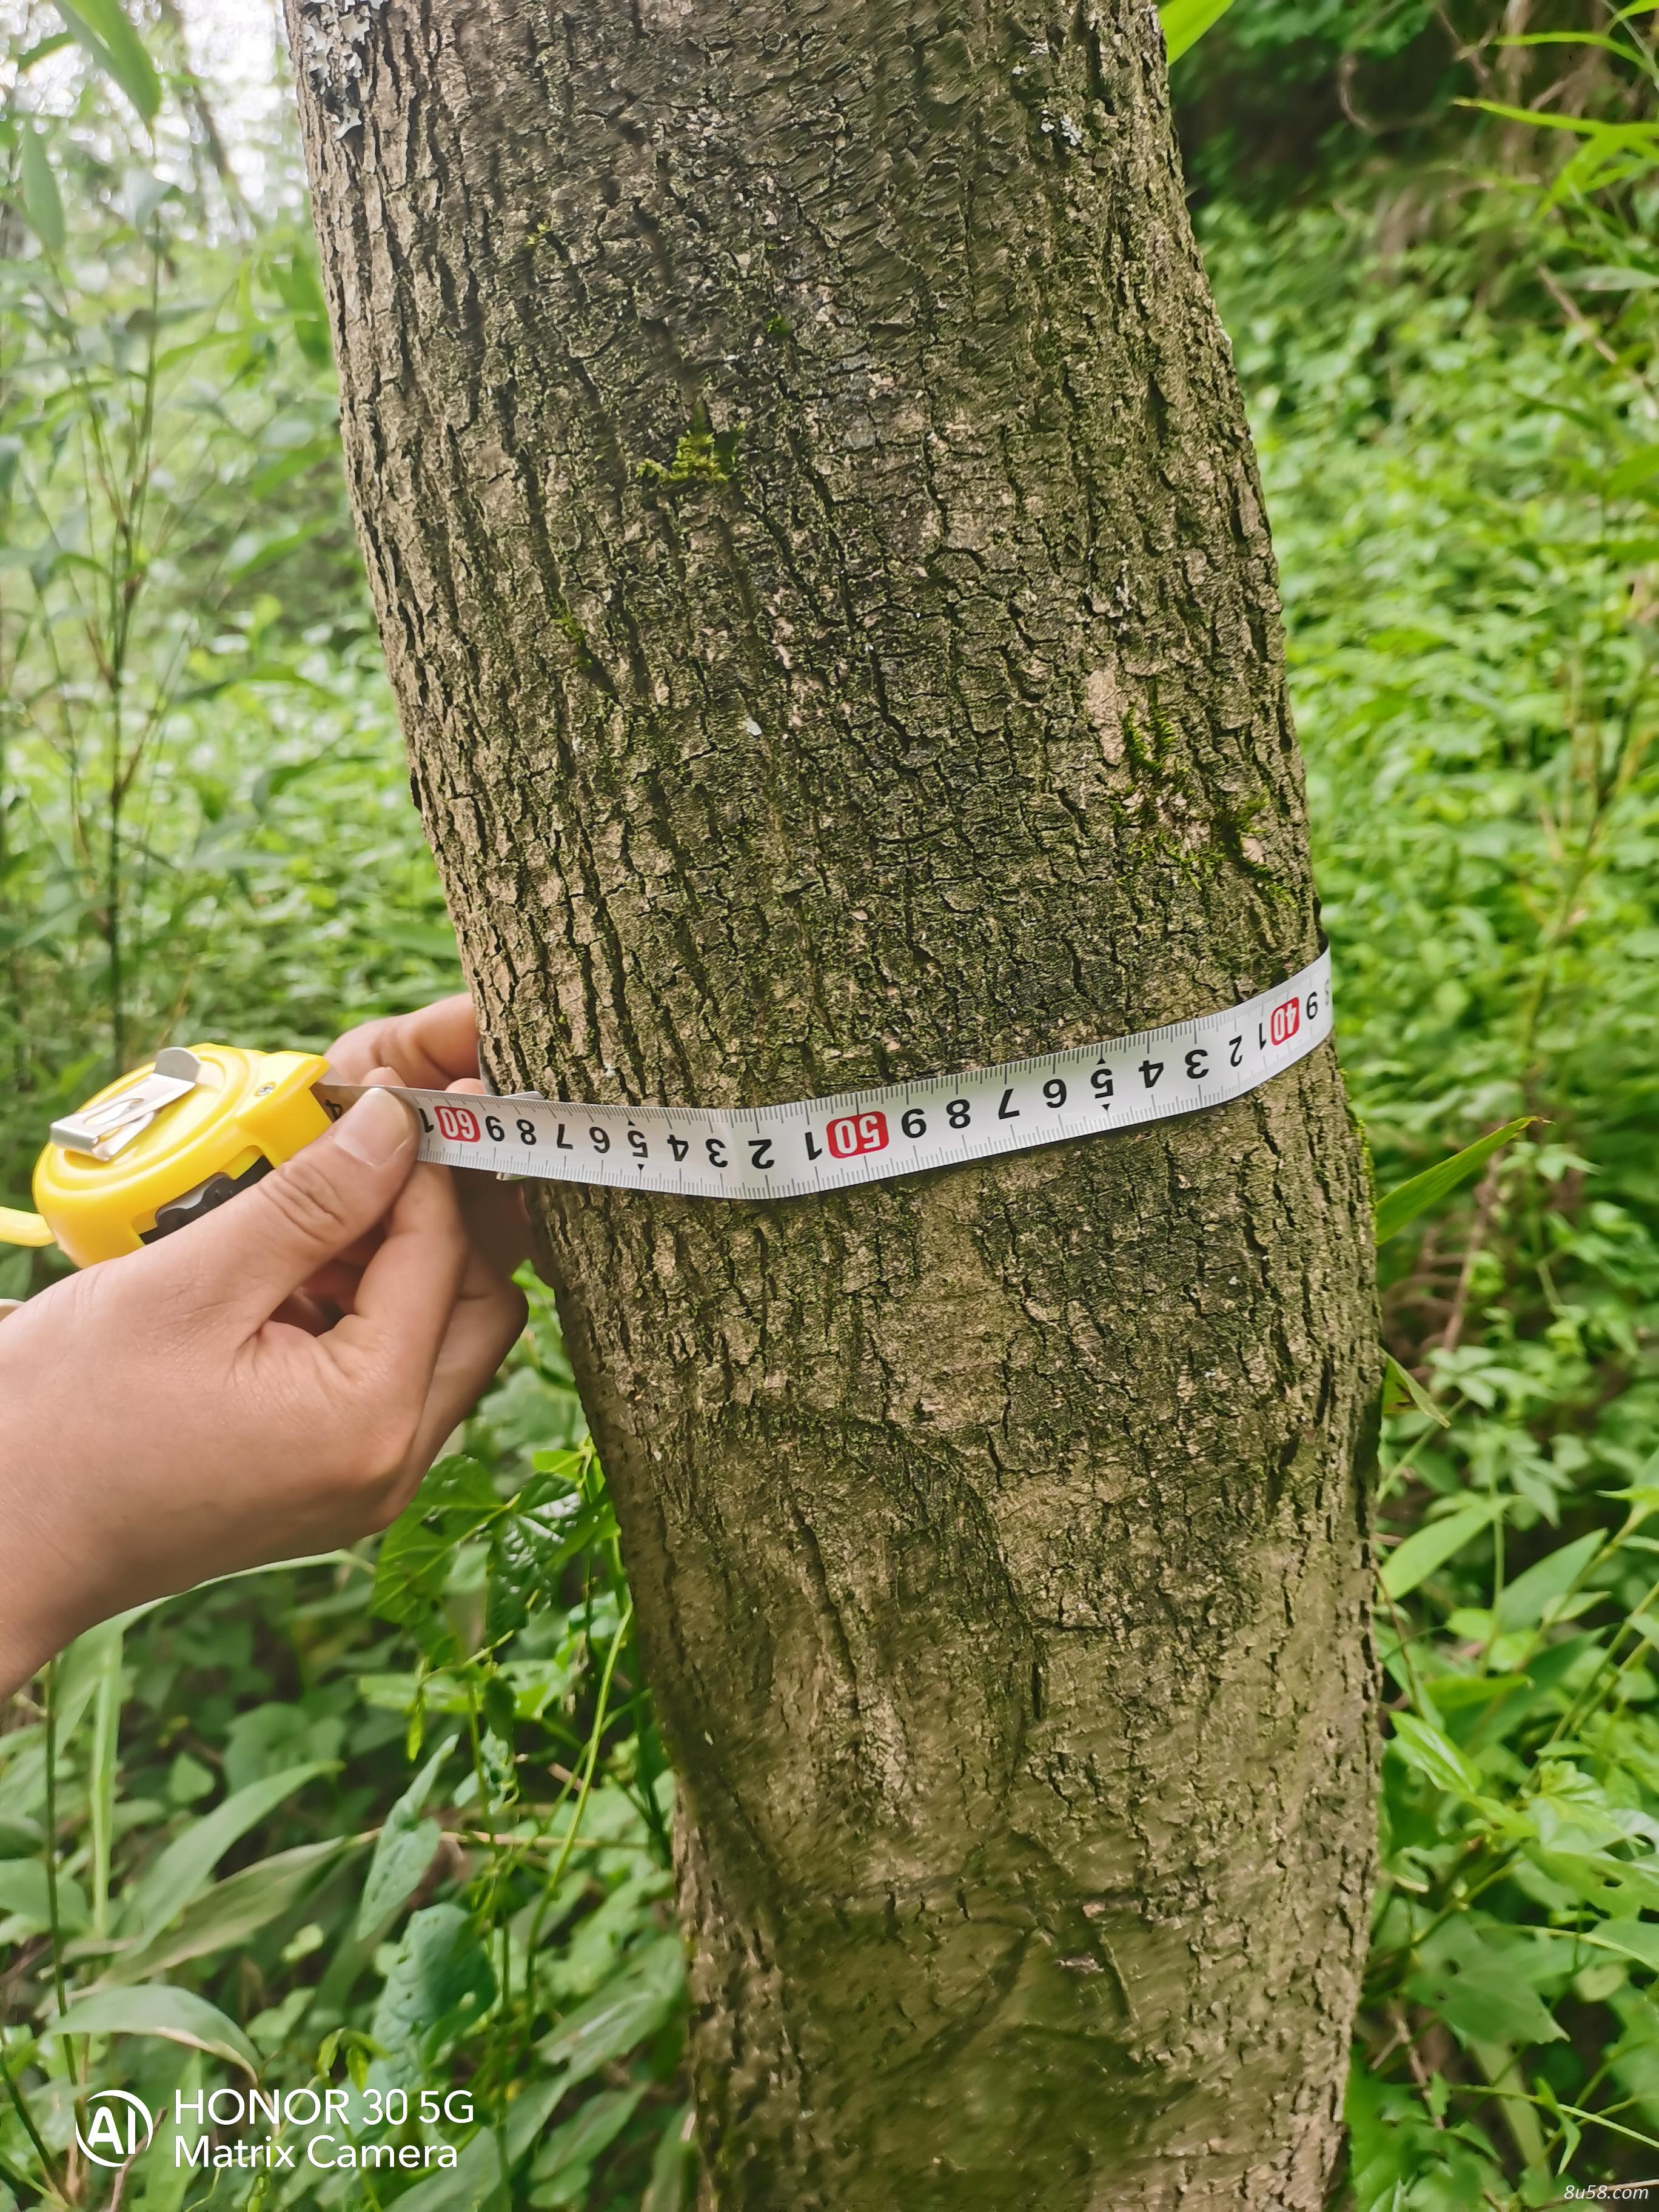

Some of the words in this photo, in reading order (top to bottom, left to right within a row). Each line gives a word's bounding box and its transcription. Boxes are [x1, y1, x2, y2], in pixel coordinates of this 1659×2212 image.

[1305, 991, 1318, 1021] 9
[1258, 1022, 1267, 1050] 1
[1273, 1002, 1297, 1041] 40
[1184, 1049, 1210, 1079] 3
[1228, 1034, 1243, 1067] 2
[1091, 1068, 1114, 1099] 5
[1138, 1059, 1165, 1088] 4
[997, 1088, 1021, 1121] 7
[1042, 1079, 1067, 1108] 6
[418, 1108, 434, 1133] 1
[441, 1108, 476, 1140] 60
[484, 1115, 506, 1142] 9
[900, 1108, 927, 1139] 9
[946, 1099, 971, 1129] 8
[515, 1119, 537, 1145] 8
[555, 1123, 574, 1150] 7
[588, 1126, 611, 1154] 6
[627, 1130, 649, 1159] 5
[805, 1131, 823, 1161] 1
[833, 1114, 880, 1155] 50
[666, 1134, 690, 1162] 4
[705, 1138, 728, 1168] 3
[748, 1139, 776, 1170] 2
